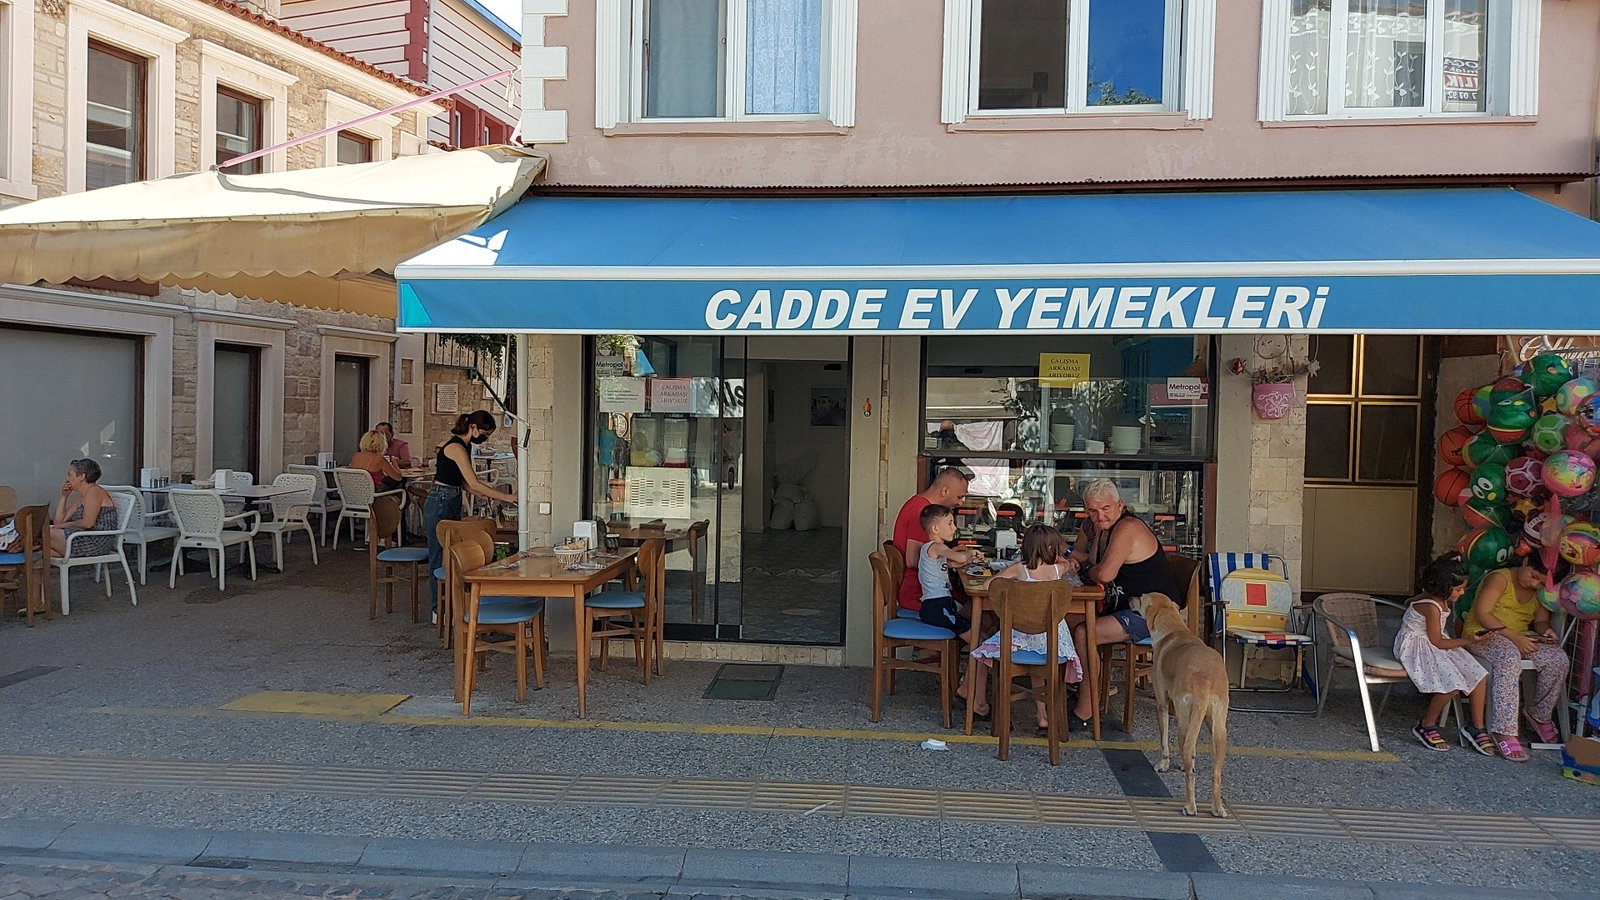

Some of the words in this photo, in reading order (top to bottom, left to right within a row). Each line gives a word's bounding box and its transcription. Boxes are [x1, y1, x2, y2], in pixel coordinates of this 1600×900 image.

[705, 289, 888, 329] CADDE
[897, 288, 980, 329] EV
[595, 361, 623, 369] Metropol
[1168, 383, 1201, 391] Metropol
